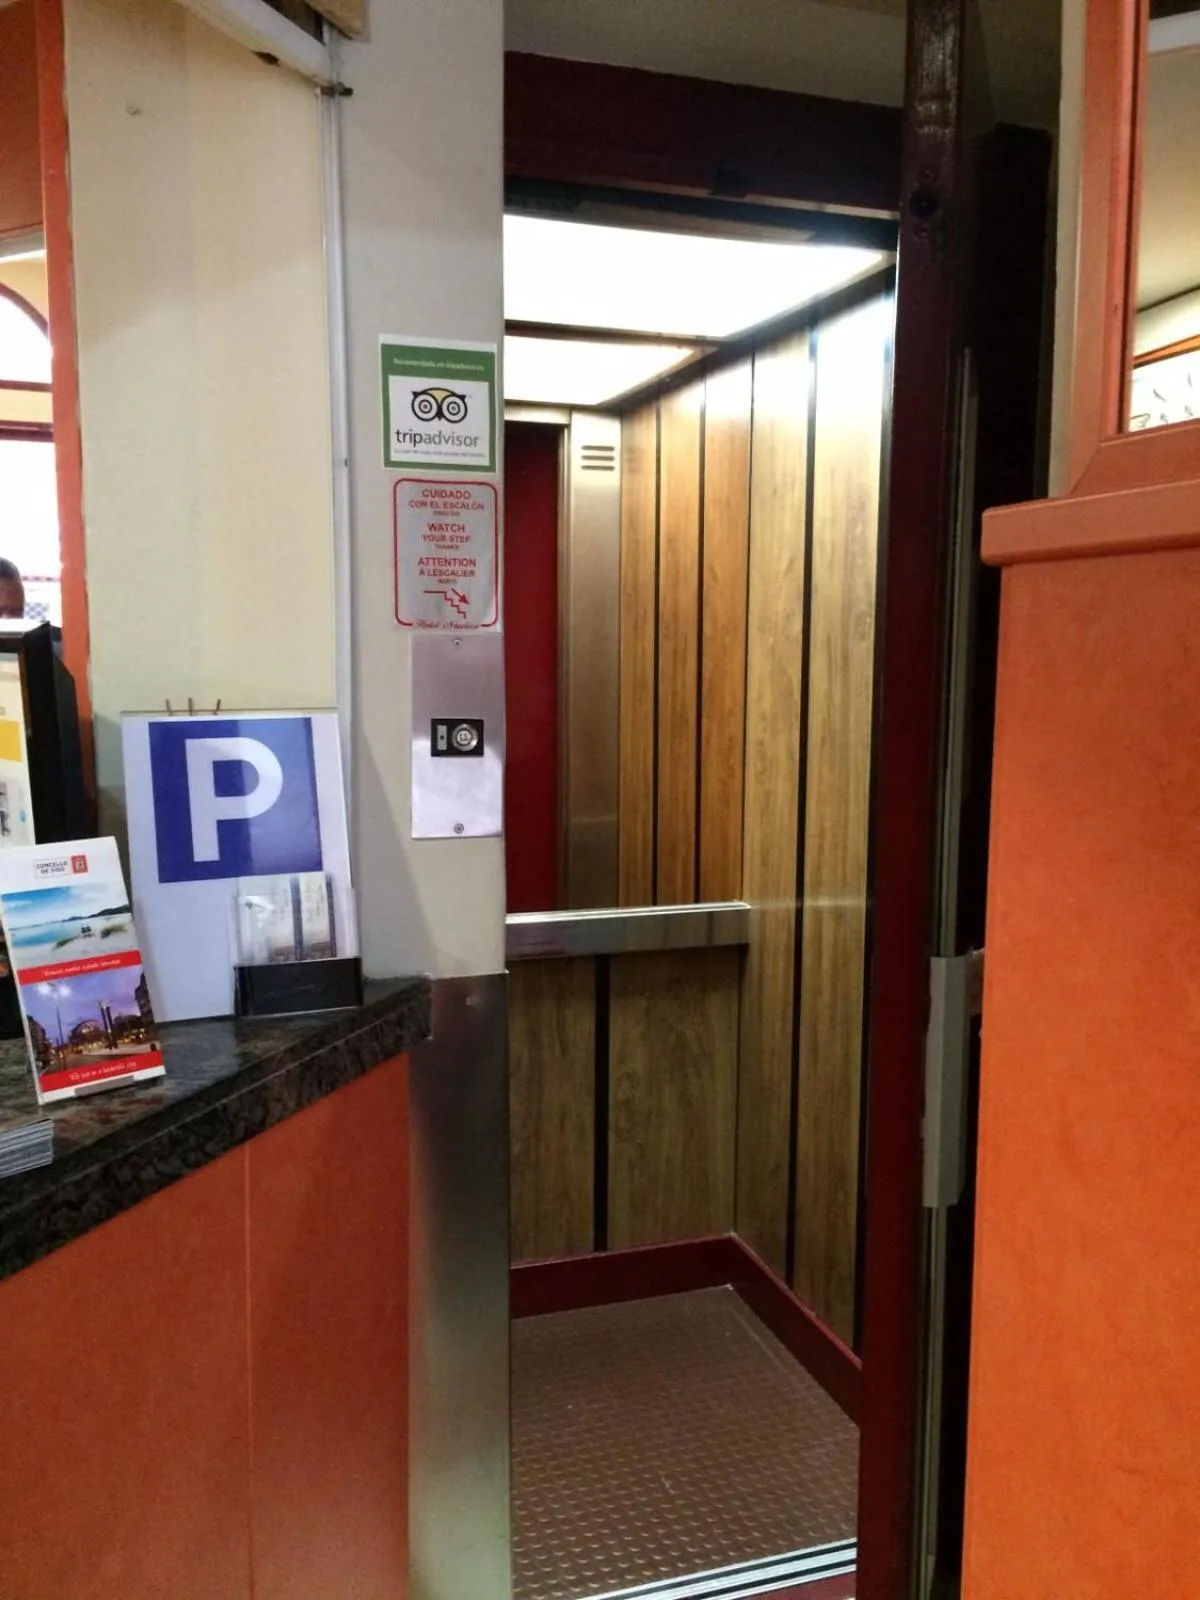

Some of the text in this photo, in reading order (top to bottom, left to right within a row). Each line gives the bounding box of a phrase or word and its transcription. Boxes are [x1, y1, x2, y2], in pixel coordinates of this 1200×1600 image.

[395, 428, 479, 448] tripadvisor
[422, 488, 471, 500] CUIDADO
[408, 500, 428, 509] CON
[430, 501, 440, 510] EL
[427, 522, 465, 533] WATCH
[422, 534, 472, 544] YOUR STEP
[418, 557, 477, 568] ATTENTION
[185, 736, 284, 863] P
